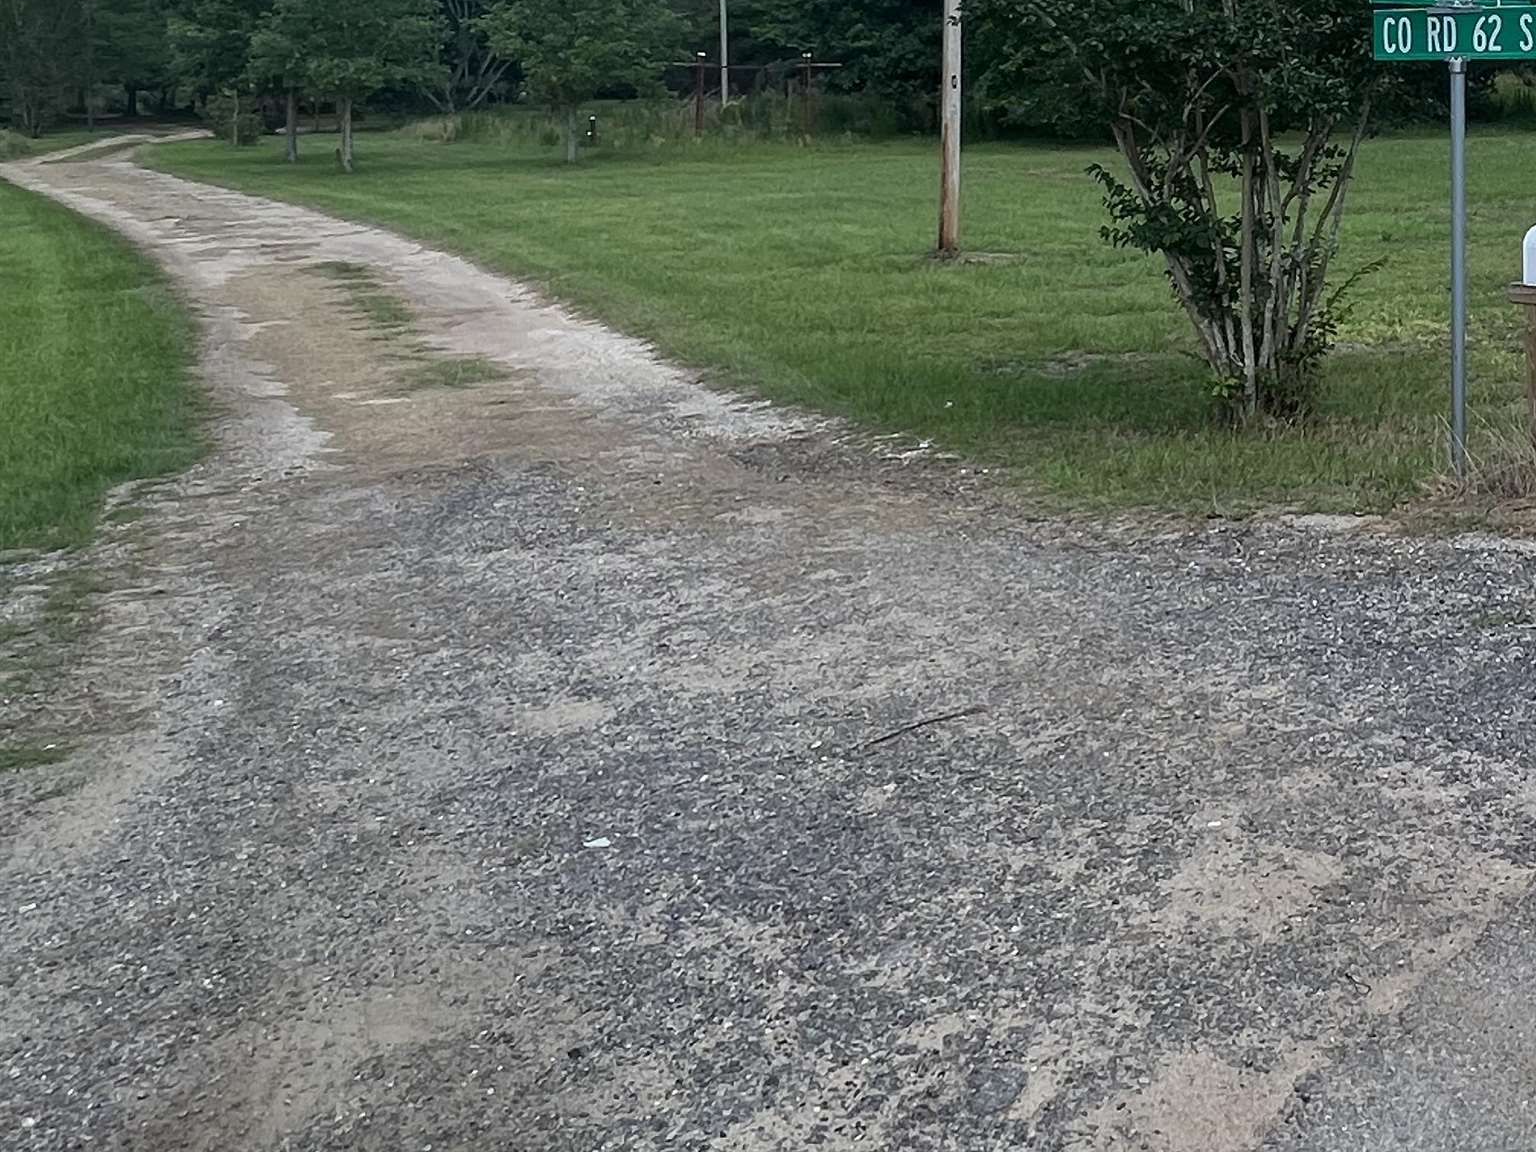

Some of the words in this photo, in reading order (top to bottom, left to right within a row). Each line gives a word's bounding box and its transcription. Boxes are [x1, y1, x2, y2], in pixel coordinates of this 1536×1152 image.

[1383, 16, 1412, 54] CO
[1427, 16, 1457, 52] RD
[1472, 14, 1502, 52] 62
[1519, 13, 1534, 52] S
